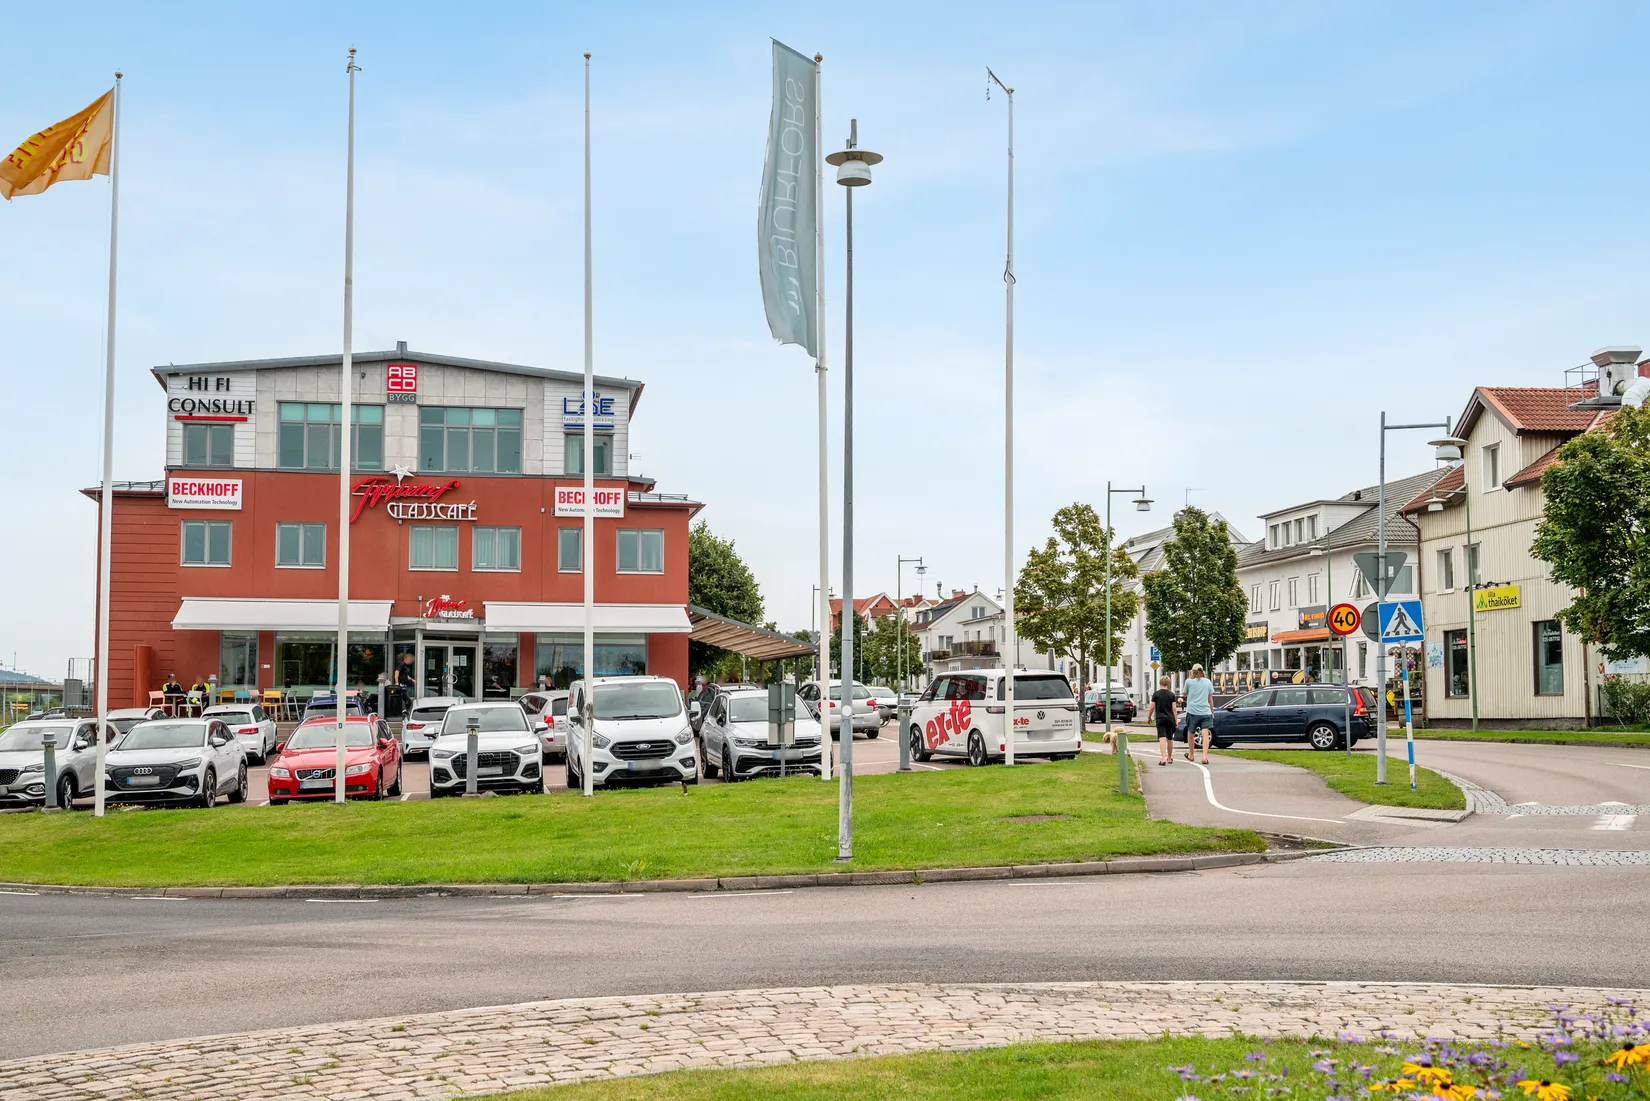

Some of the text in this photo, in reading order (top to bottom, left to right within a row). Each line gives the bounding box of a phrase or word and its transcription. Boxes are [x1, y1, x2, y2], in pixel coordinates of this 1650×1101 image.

[188, 377, 230, 391] HI FI
[389, 393, 415, 402] BYGG
[168, 398, 255, 415] CONSULT
[172, 482, 239, 497] BECKHOFF
[212, 499, 238, 507] Technology
[349, 476, 460, 523] Triumf
[387, 500, 477, 520] GLASSCAFÉ
[596, 507, 620, 515] Technology
[1488, 595, 1518, 607] thaiköket
[1333, 611, 1356, 627] 40
[926, 699, 972, 750] ex-te
[1013, 717, 1030, 726] x-te
